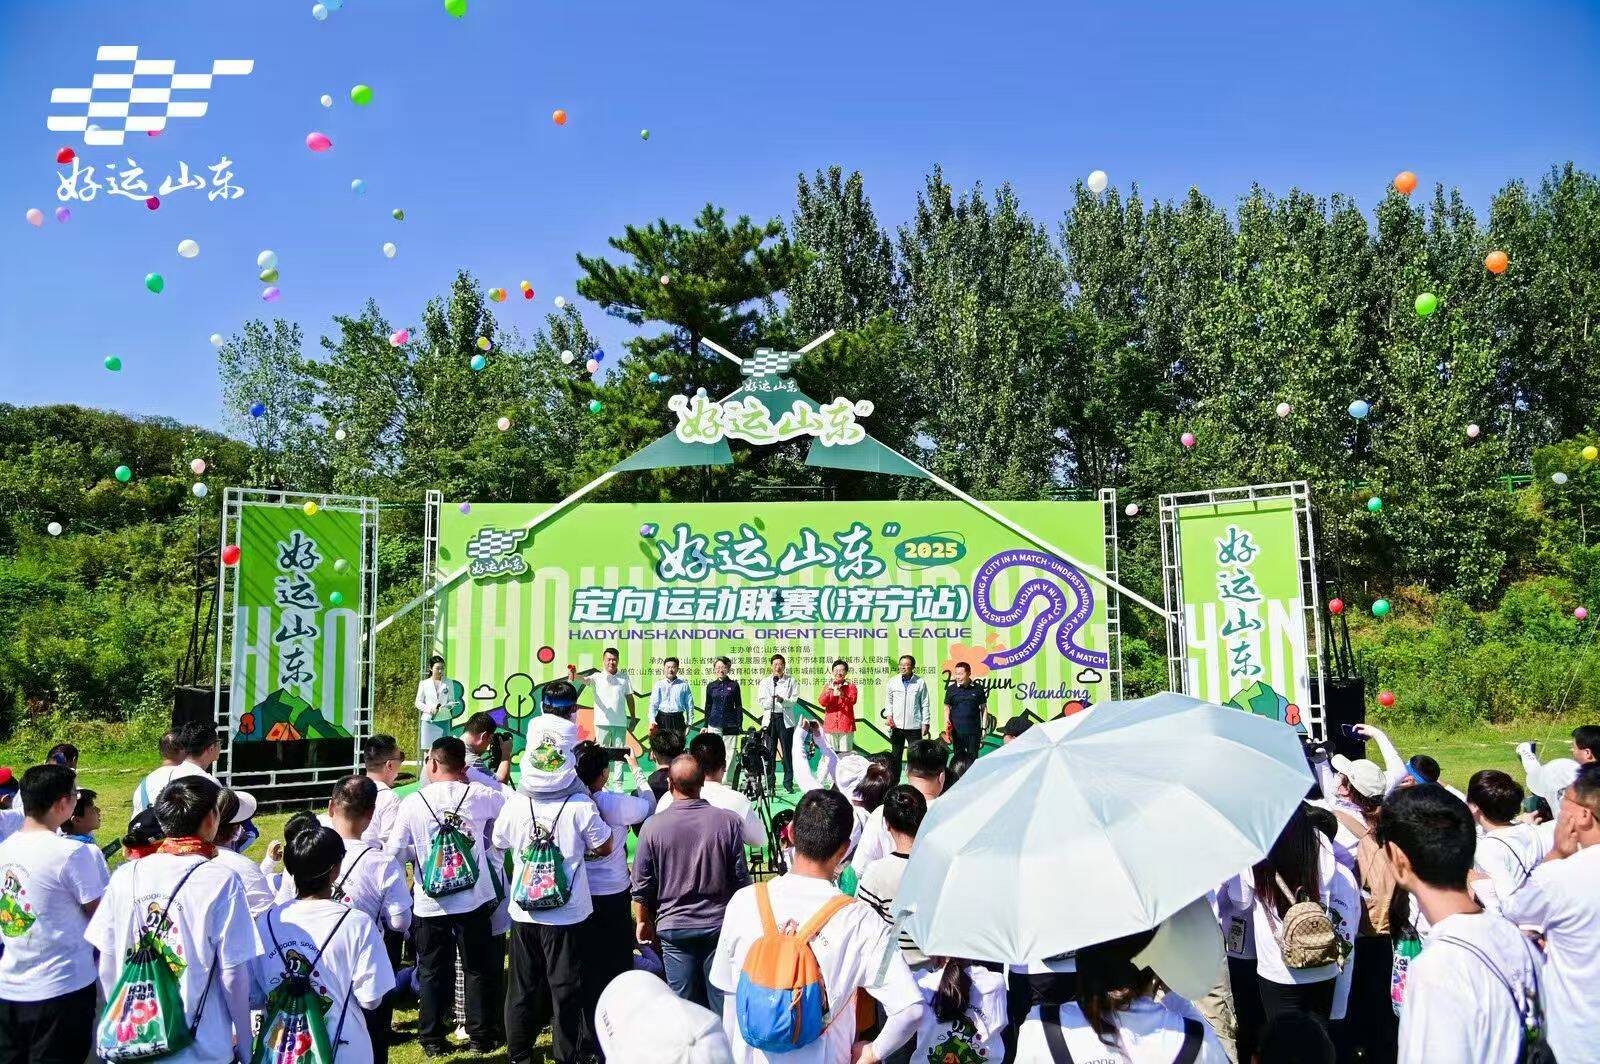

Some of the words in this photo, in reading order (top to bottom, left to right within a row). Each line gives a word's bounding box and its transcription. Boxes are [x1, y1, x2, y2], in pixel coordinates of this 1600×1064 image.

[743, 379, 798, 392] 好运山东
[904, 543, 957, 558] 2025
[471, 558, 524, 575] 好运山东
[1000, 555, 1011, 564] IN
[1019, 554, 1047, 565] MATCH
[985, 560, 1001, 575] CITY
[1042, 583, 1048, 591] A
[1051, 561, 1089, 619] UNDERSTANDING
[1018, 583, 1041, 606] MATCH
[1048, 589, 1057, 600] IN
[275, 532, 320, 685] 好运山东
[978, 582, 1022, 623] UNDERSTANDING
[1218, 528, 1262, 677] 好运山东
[1071, 616, 1079, 624] A
[569, 629, 744, 640] HAOYUNSHANDONG
[755, 628, 888, 640] ORIENTEERING
[898, 628, 972, 639] LEAGUE
[1060, 623, 1073, 640] CITY
[1062, 641, 1070, 651] IN
[1069, 648, 1075, 656] A
[1076, 653, 1105, 664] MATCH
[1015, 681, 1092, 706] Shandong
